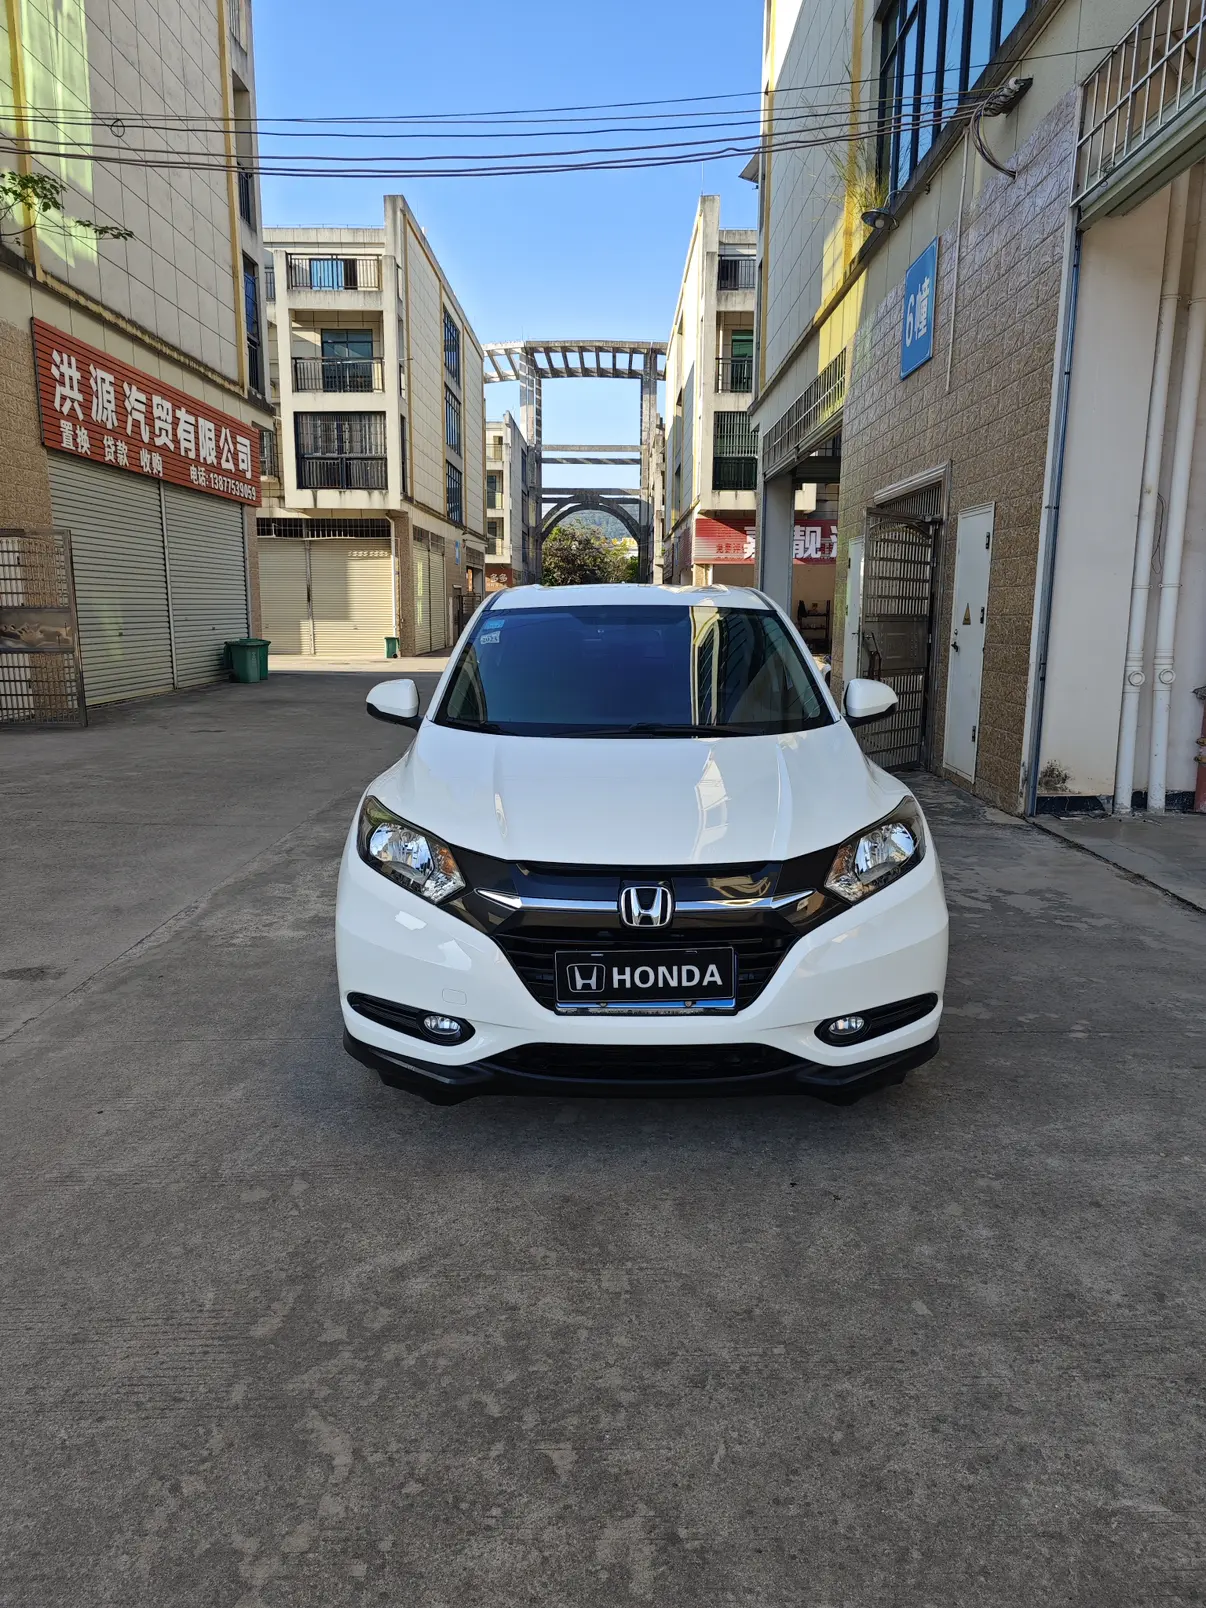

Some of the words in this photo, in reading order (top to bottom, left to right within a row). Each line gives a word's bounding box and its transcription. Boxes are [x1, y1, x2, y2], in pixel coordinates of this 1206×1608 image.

[905, 276, 930, 347] 6幢
[50, 349, 252, 479] 洪源汽贸有限公司
[60, 419, 91, 455] 置换
[103, 435, 129, 467] 贷款
[140, 448, 163, 477] 收购
[612, 964, 723, 989] HONDA
